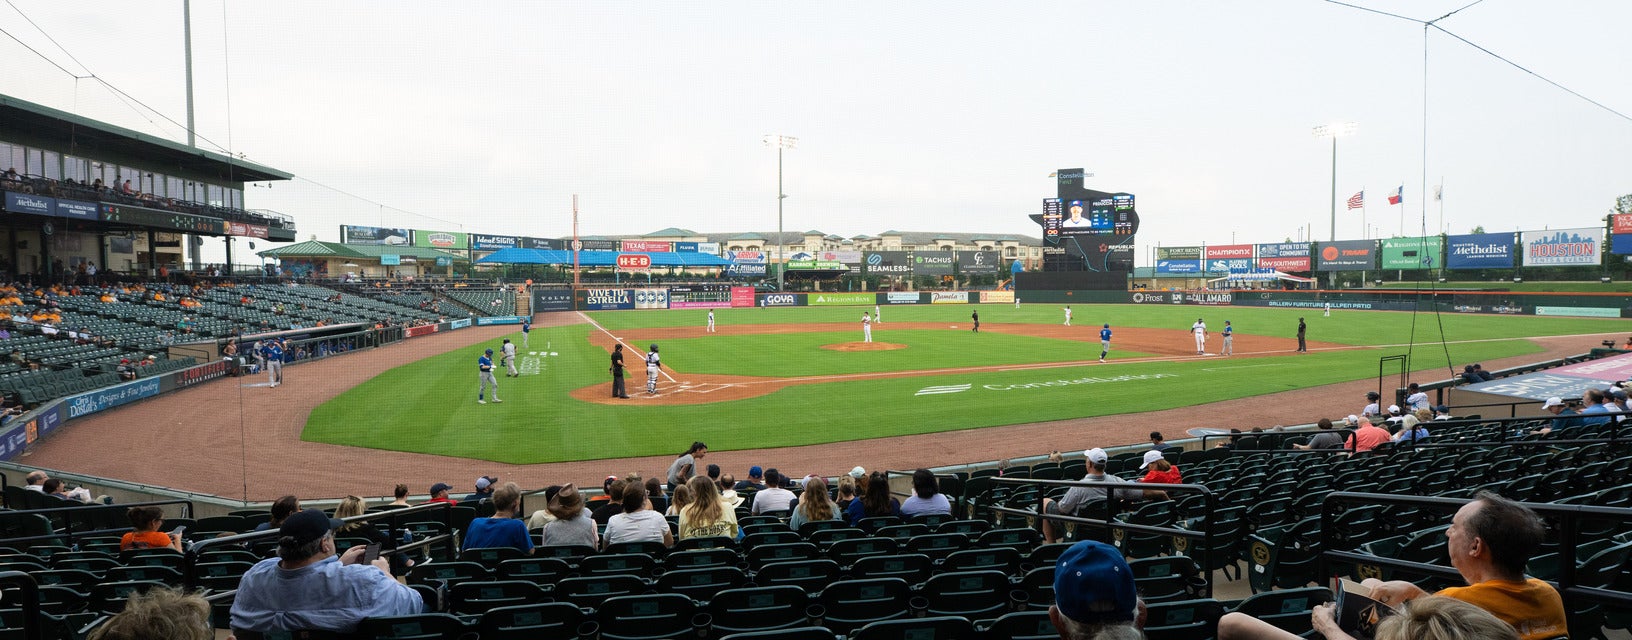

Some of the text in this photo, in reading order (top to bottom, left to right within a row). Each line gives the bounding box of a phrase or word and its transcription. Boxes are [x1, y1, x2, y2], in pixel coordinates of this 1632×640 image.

[1453, 245, 1508, 256] Methodist
[1531, 242, 1594, 257] HOUSTON
[588, 289, 624, 297] VIVE TU
[1145, 293, 1163, 302] Frost
[587, 296, 629, 304] ESTRELLA
[767, 295, 794, 304] GOYA
[1192, 294, 1205, 302] CALL
[1206, 294, 1232, 302] AMARO
[183, 362, 225, 381] FORTIFIED
[75, 396, 89, 405] Chris
[98, 393, 119, 405] Designs
[120, 390, 125, 398] &
[127, 388, 138, 397] Fine
